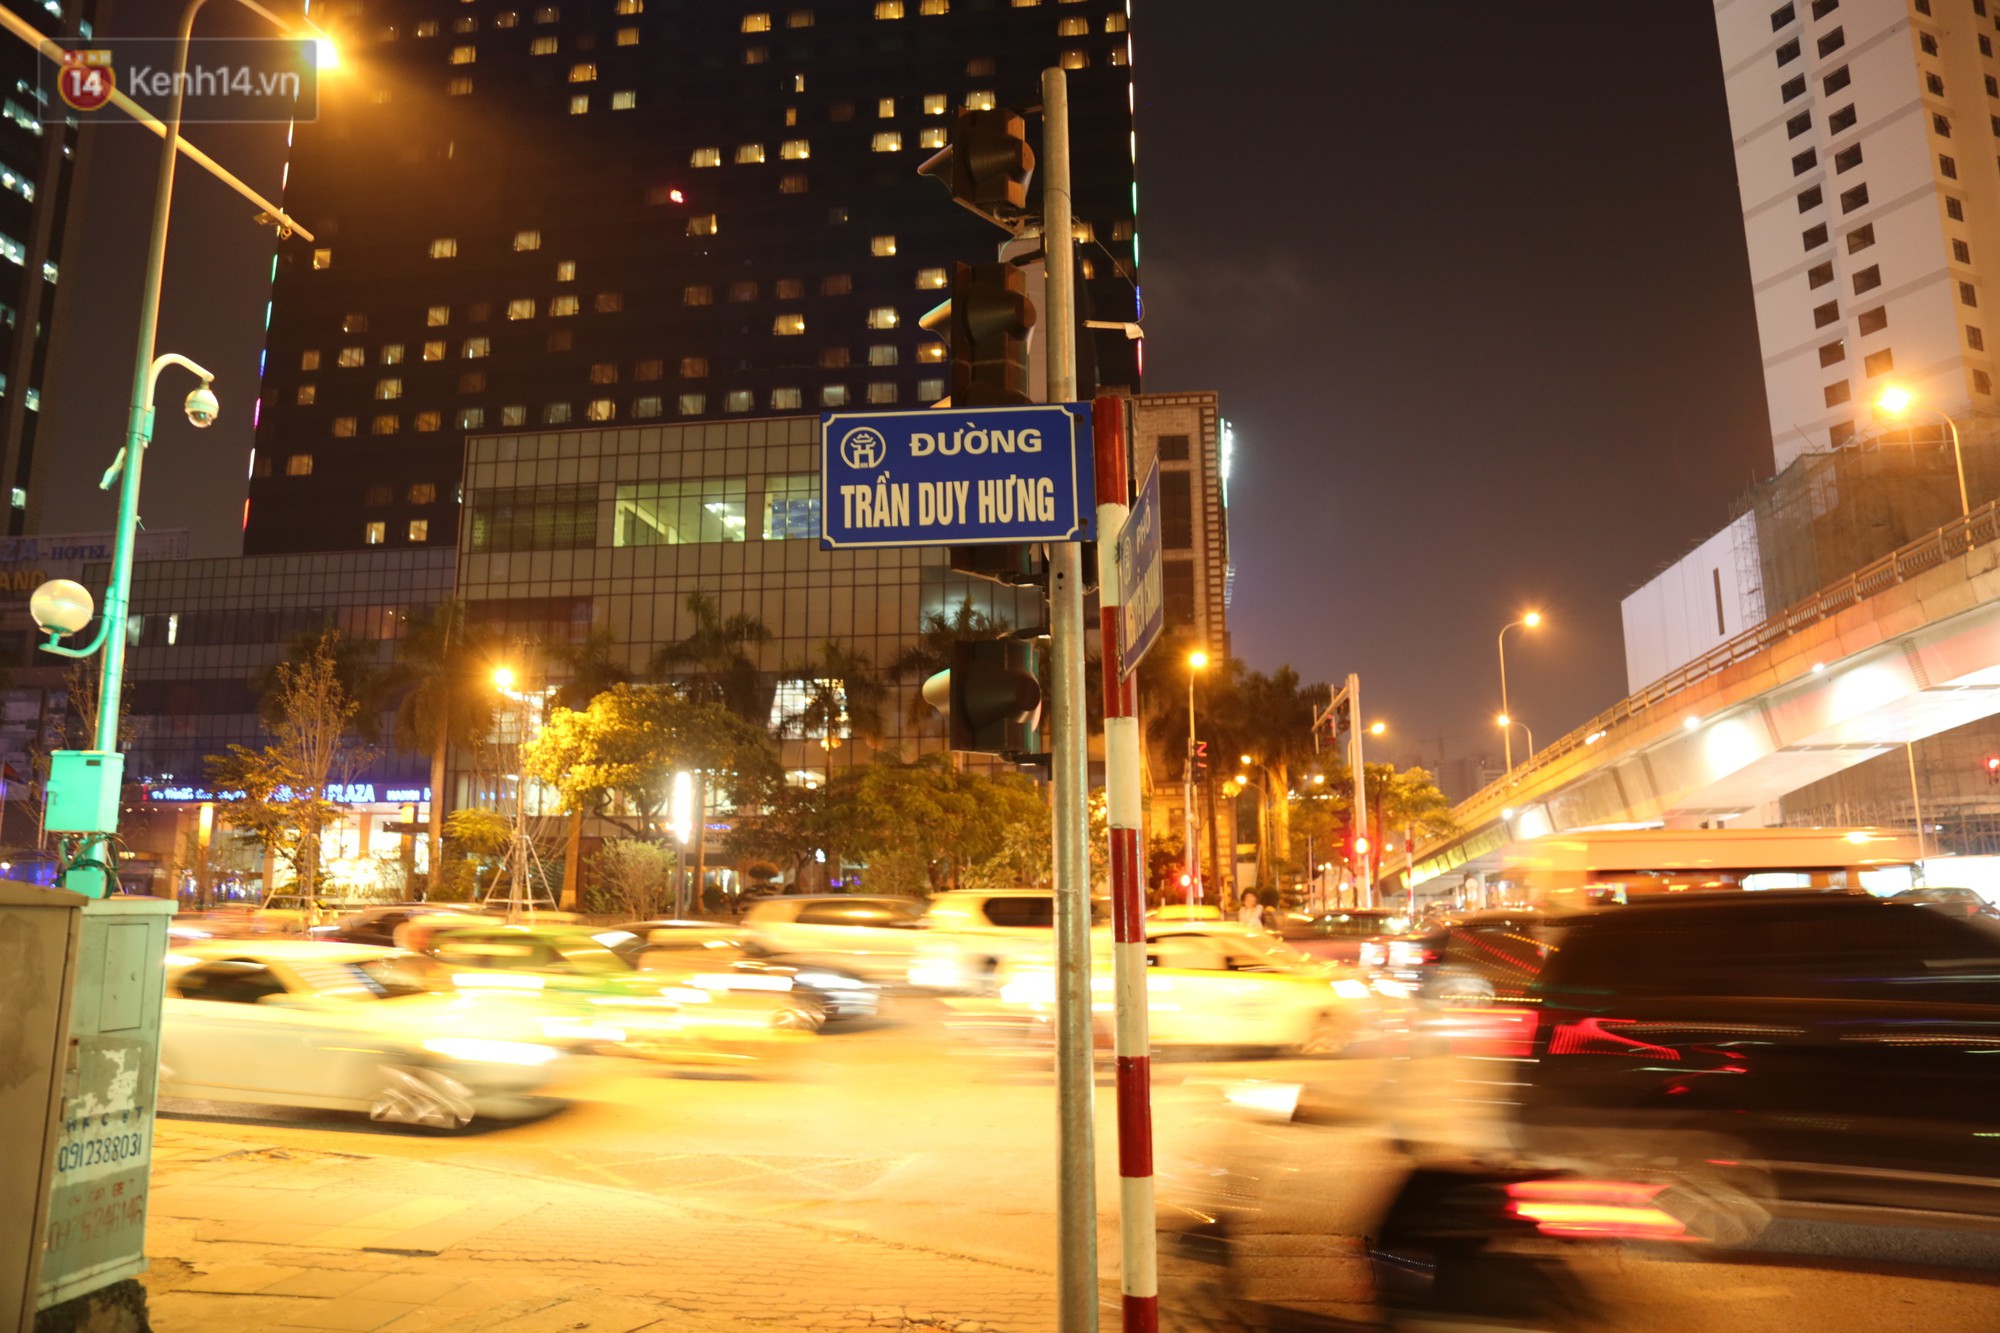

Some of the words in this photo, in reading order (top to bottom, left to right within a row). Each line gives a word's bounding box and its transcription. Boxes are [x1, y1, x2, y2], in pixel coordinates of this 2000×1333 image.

[909, 421, 1042, 457] ĐƯỜNG
[840, 470, 910, 529] TRẦN
[918, 480, 970, 526] DUY
[978, 474, 1055, 524] HƯNG
[51, 544, 111, 560] HOTEL
[327, 783, 376, 803] PLAZA
[58, 1133, 143, 1172] 0912388031
